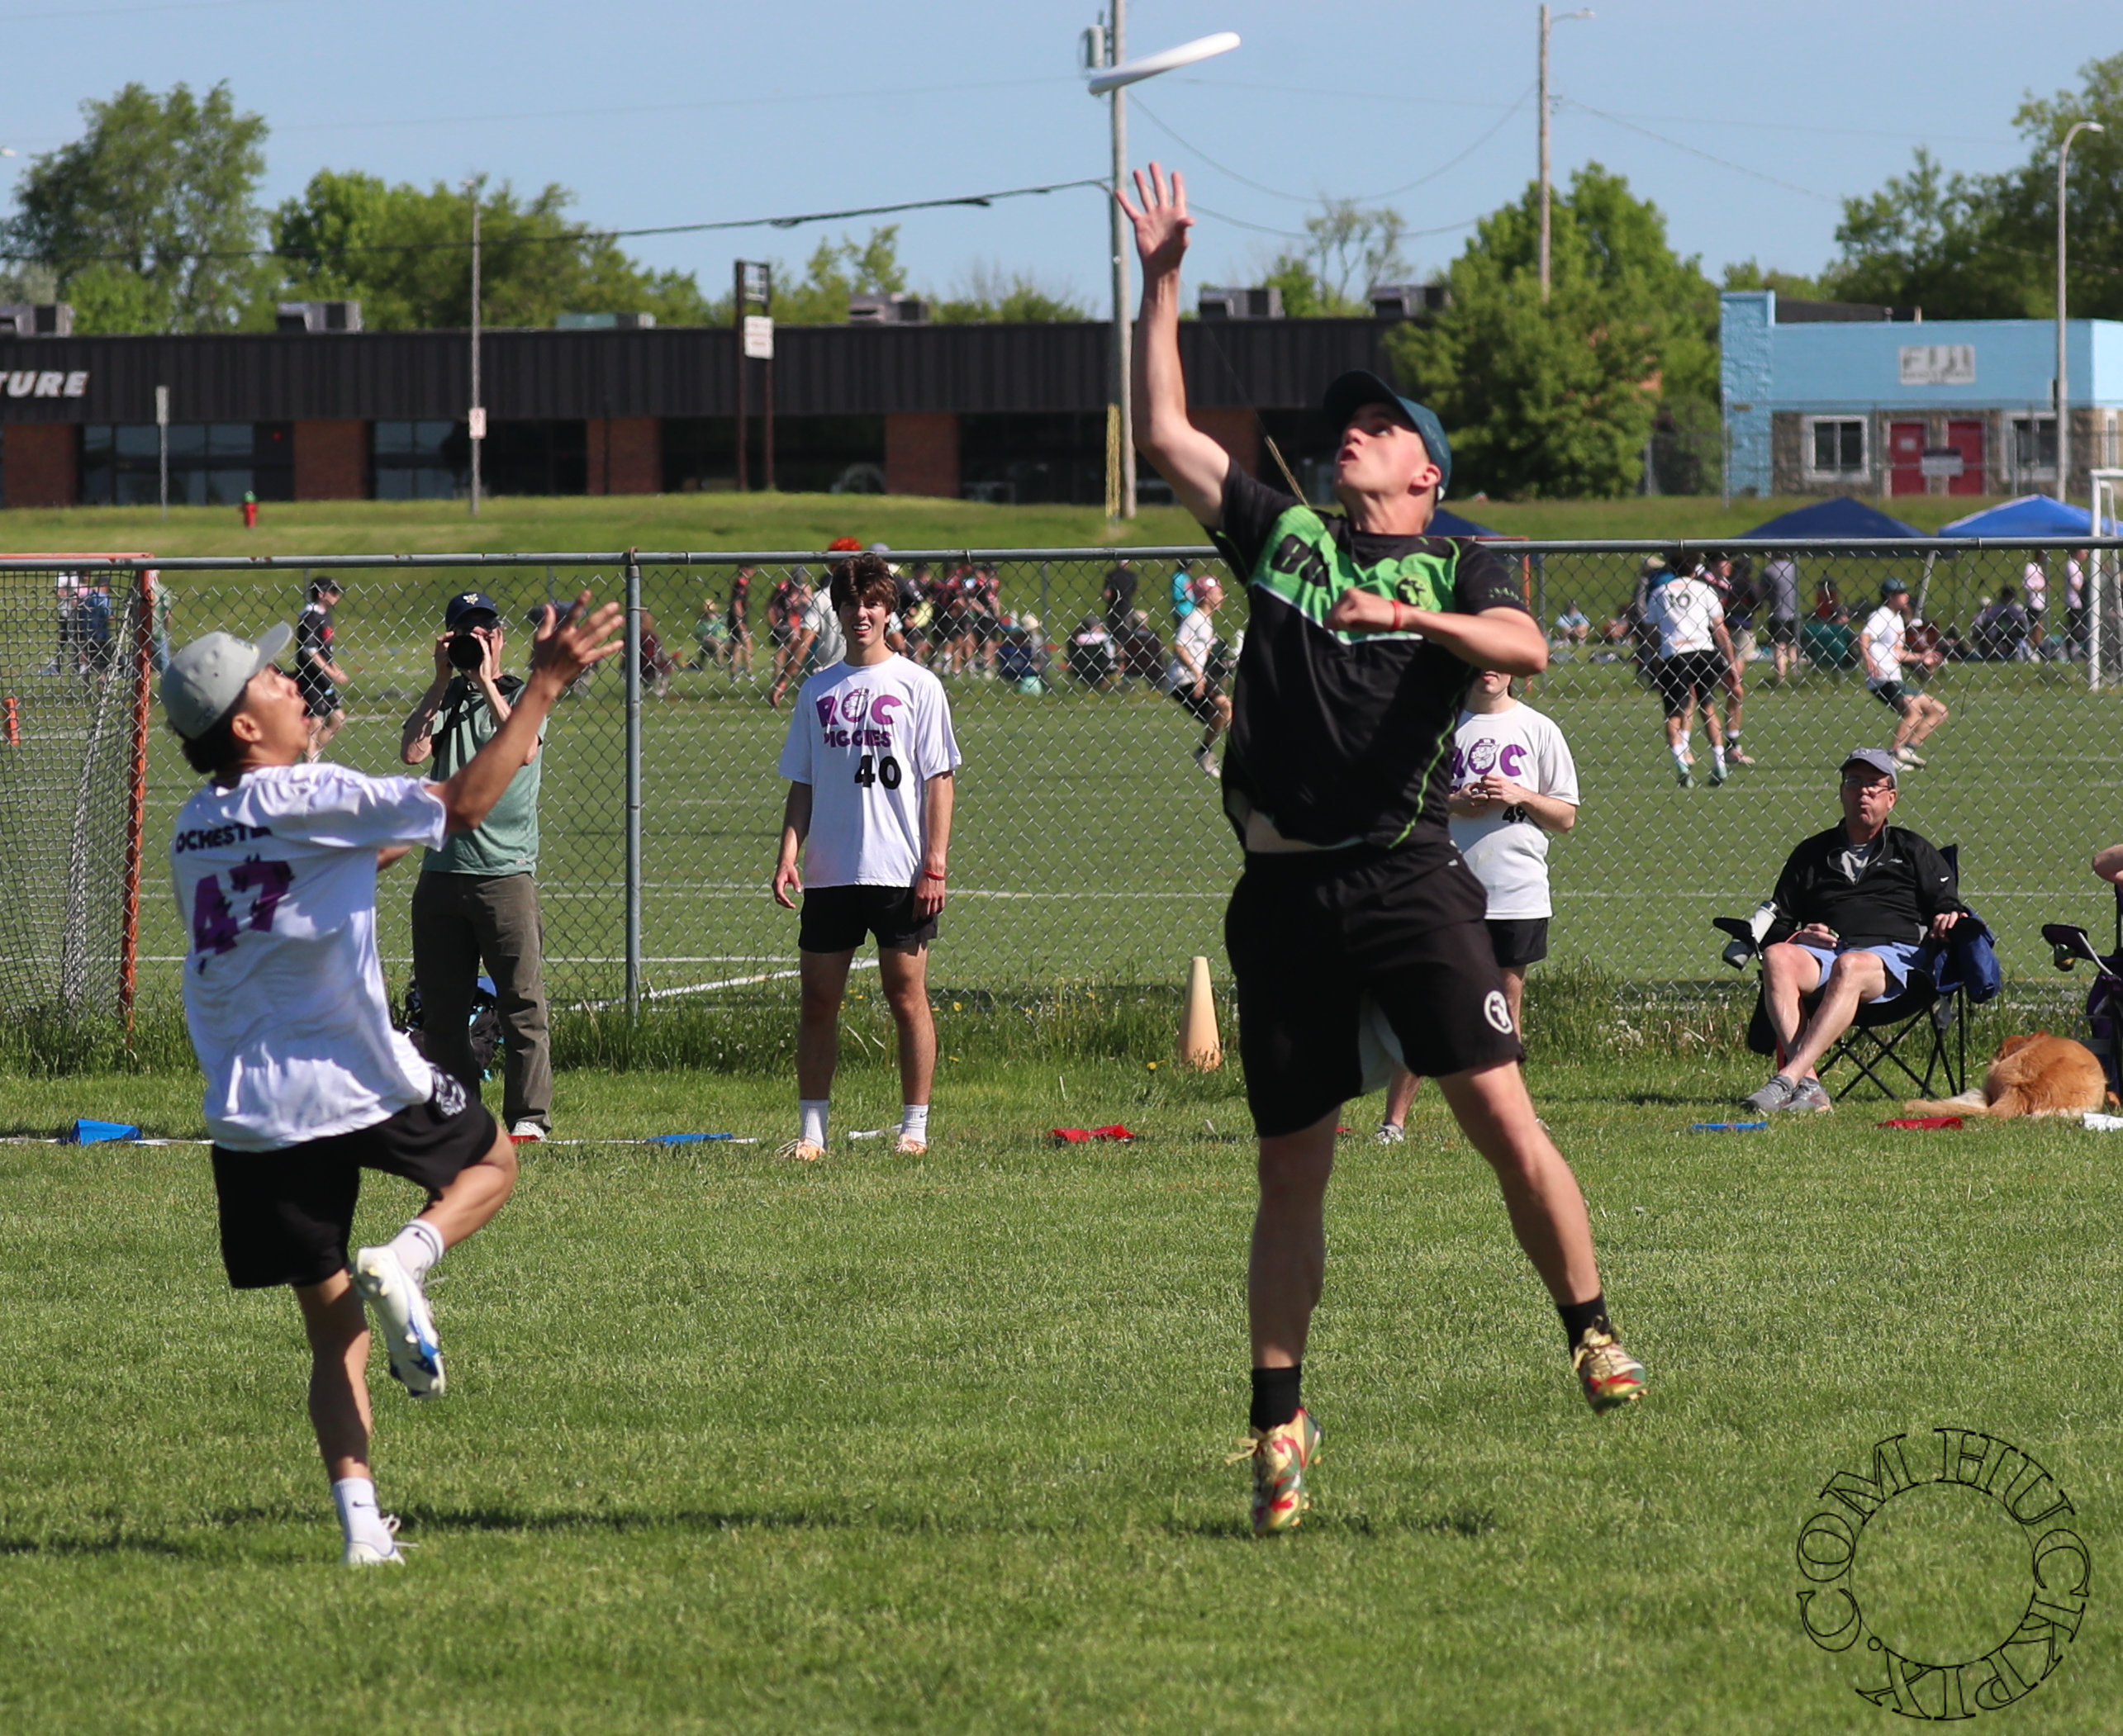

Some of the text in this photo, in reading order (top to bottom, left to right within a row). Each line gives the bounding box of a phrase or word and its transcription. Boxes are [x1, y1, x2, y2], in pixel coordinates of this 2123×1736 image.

[816, 689, 903, 728] ROC
[824, 730, 892, 747] PIGGIES
[854, 755, 902, 790] 40
[1502, 806, 1527, 823] 49
[193, 857, 295, 956] 47
